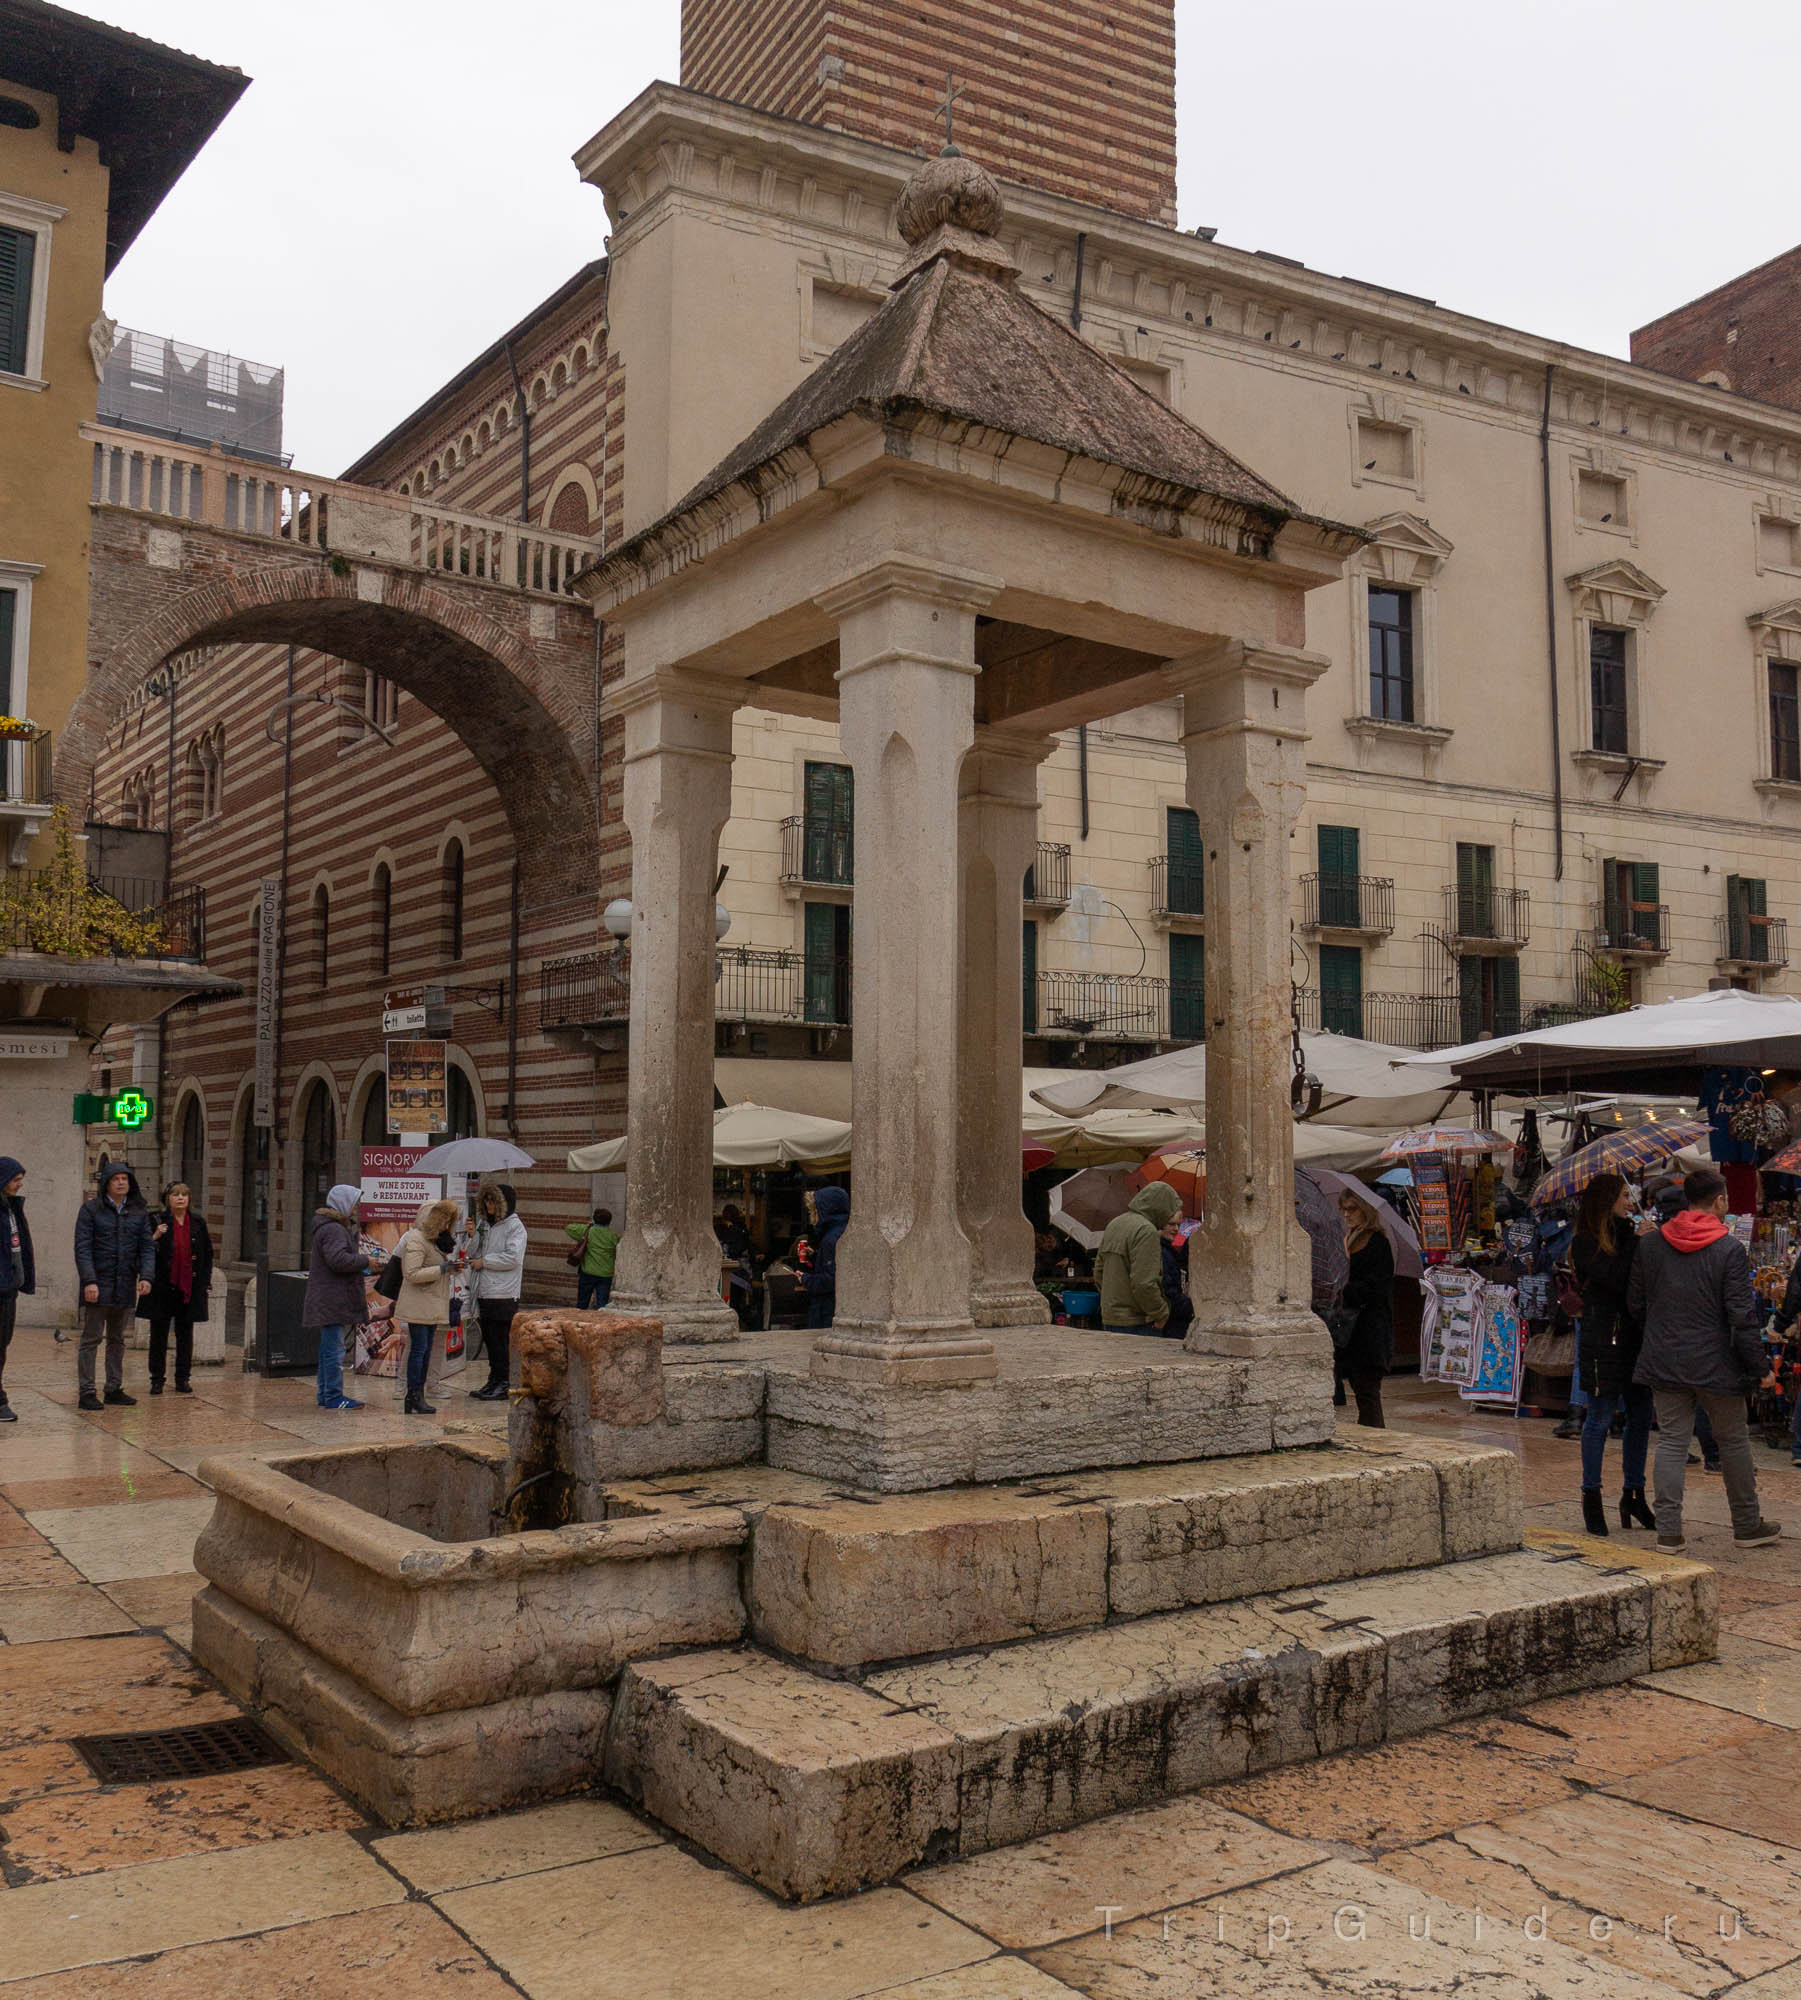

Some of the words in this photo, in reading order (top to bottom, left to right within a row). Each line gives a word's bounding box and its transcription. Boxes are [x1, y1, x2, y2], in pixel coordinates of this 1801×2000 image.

[262, 884, 275, 945] RAGIONE
[263, 948, 273, 973] della
[260, 977, 272, 1041] PALAZZO
[373, 1192, 379, 1200] &
[380, 1192, 430, 1200] RESTAURANT
[378, 1181, 399, 1190] WINE
[400, 1181, 425, 1190] STORE
